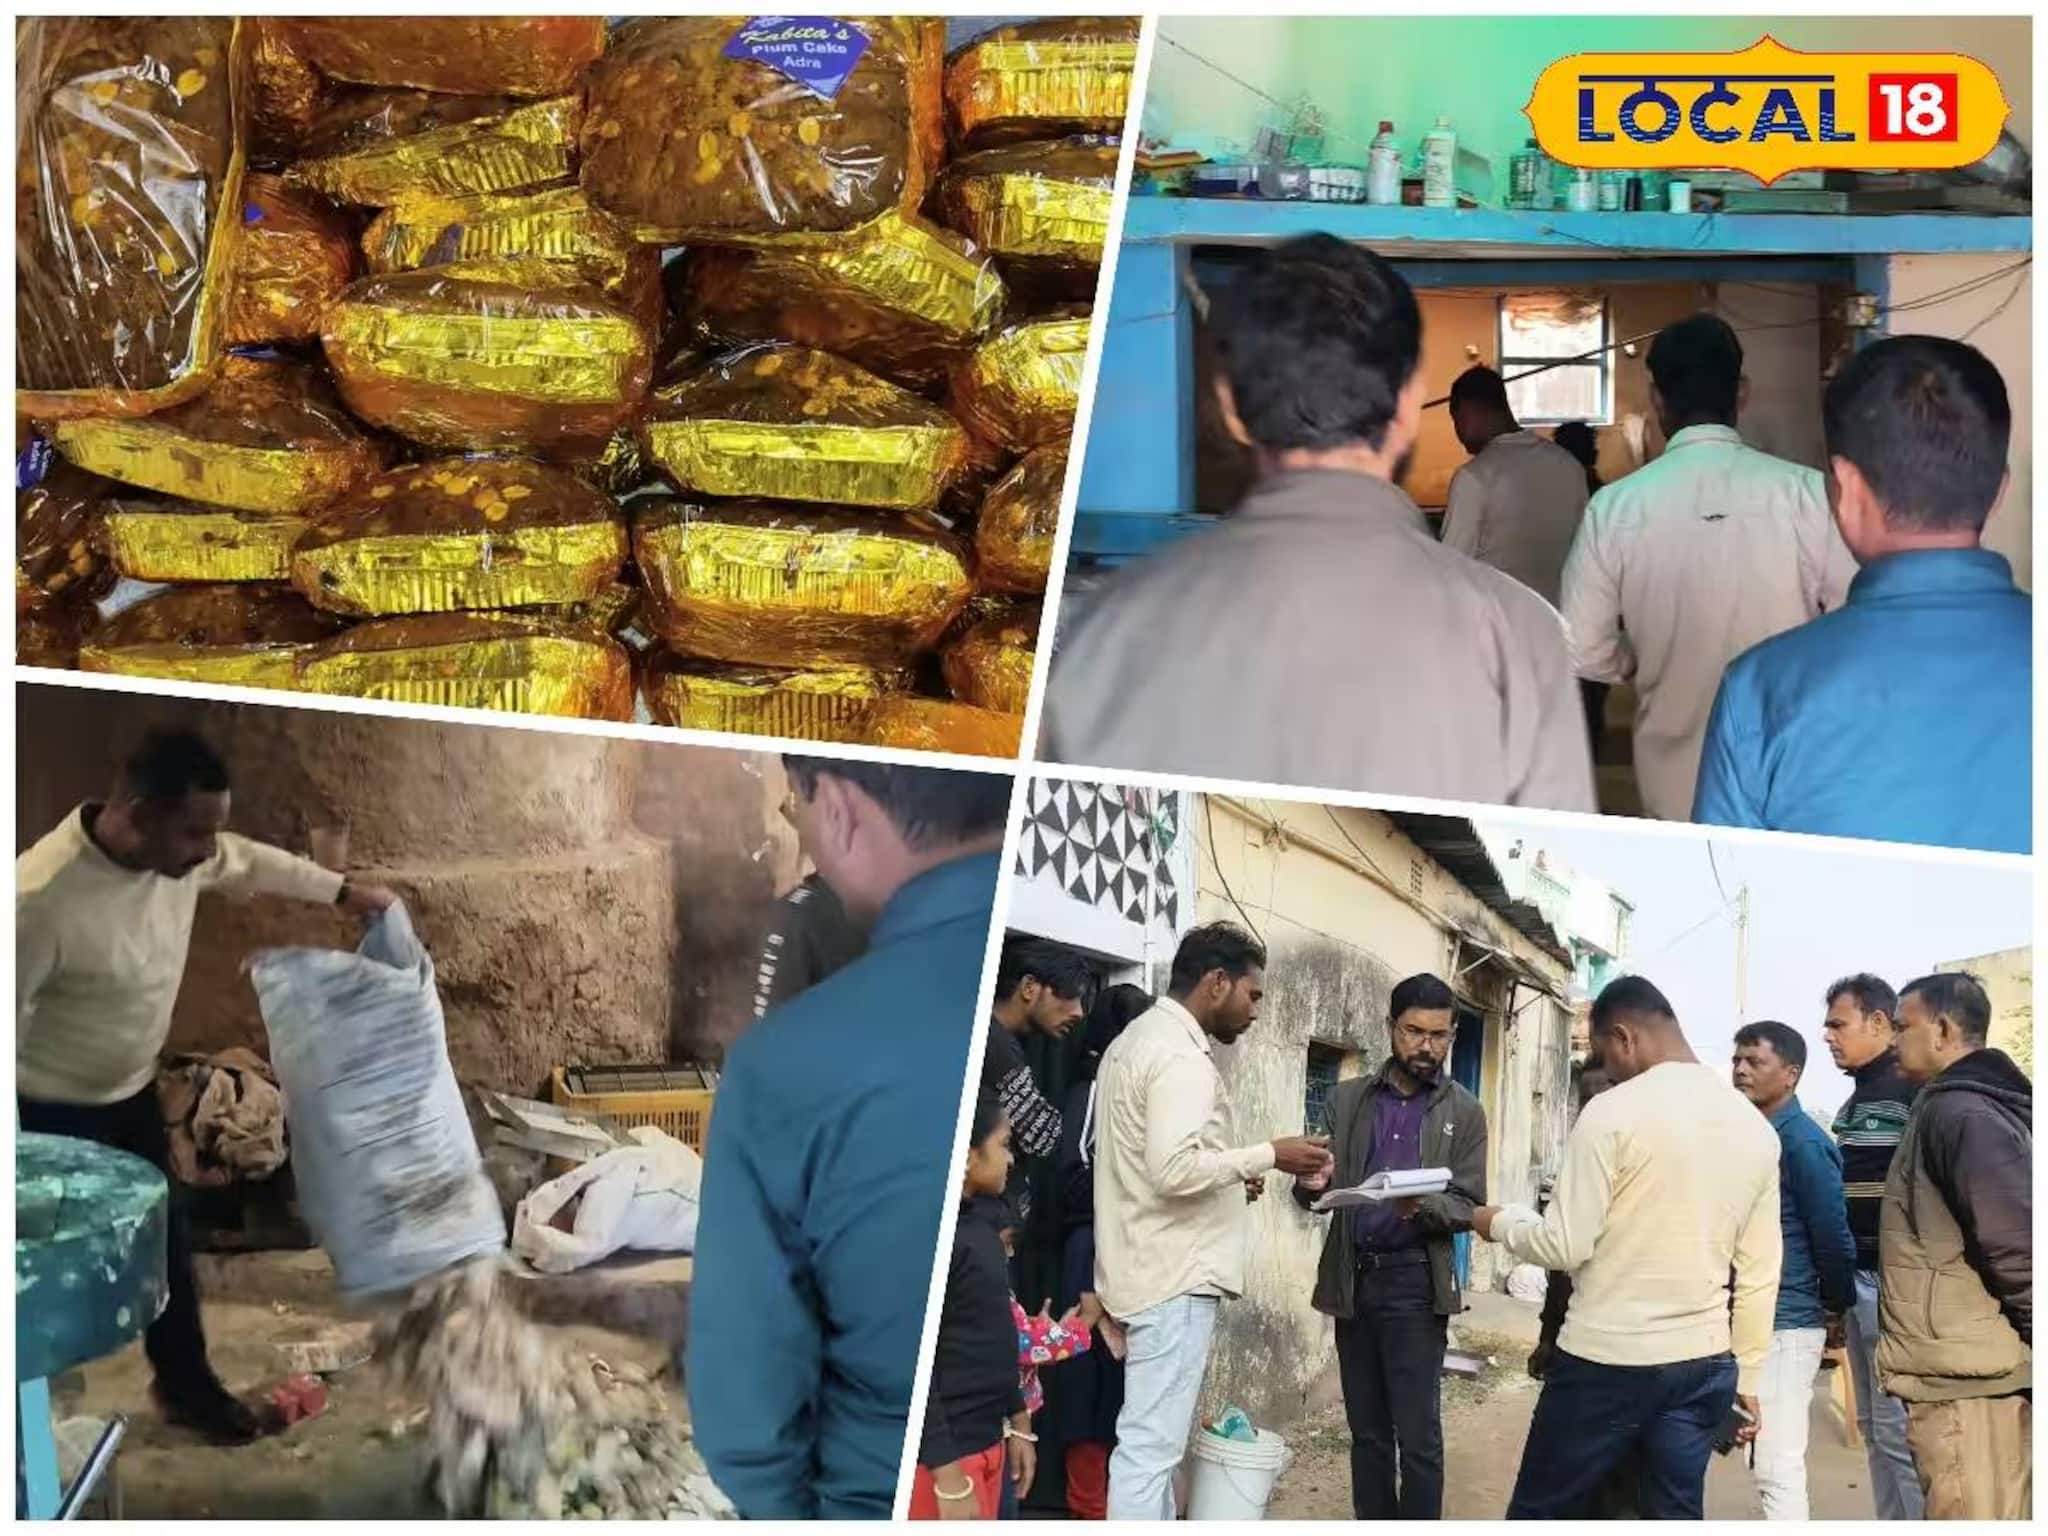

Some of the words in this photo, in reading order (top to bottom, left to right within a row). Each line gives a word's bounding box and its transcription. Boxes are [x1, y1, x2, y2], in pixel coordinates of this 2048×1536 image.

[739, 22, 849, 44] Kabita's
[751, 43, 798, 54] Plum
[802, 41, 848, 54] Cake
[783, 55, 822, 69] Adra
